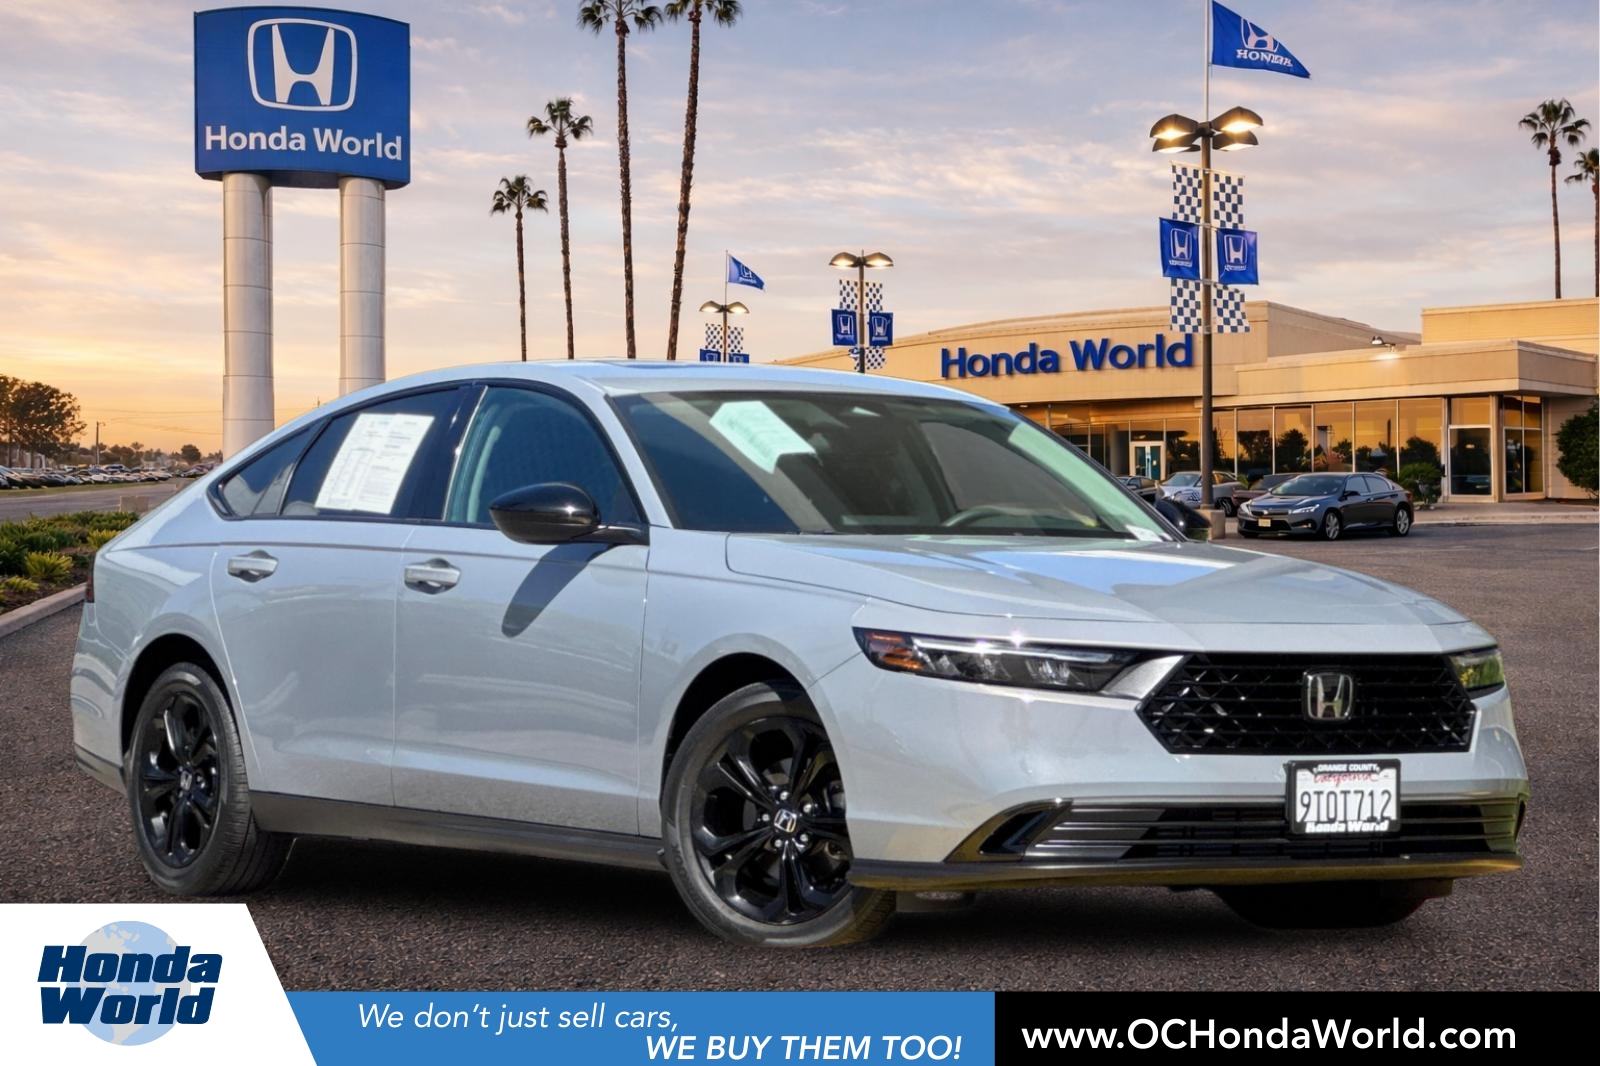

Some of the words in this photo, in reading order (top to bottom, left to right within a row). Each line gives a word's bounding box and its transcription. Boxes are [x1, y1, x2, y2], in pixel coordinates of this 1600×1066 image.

[205, 126, 306, 151] Honda
[313, 128, 402, 160] World
[941, 342, 1060, 378] Honda
[1069, 333, 1194, 371] World
